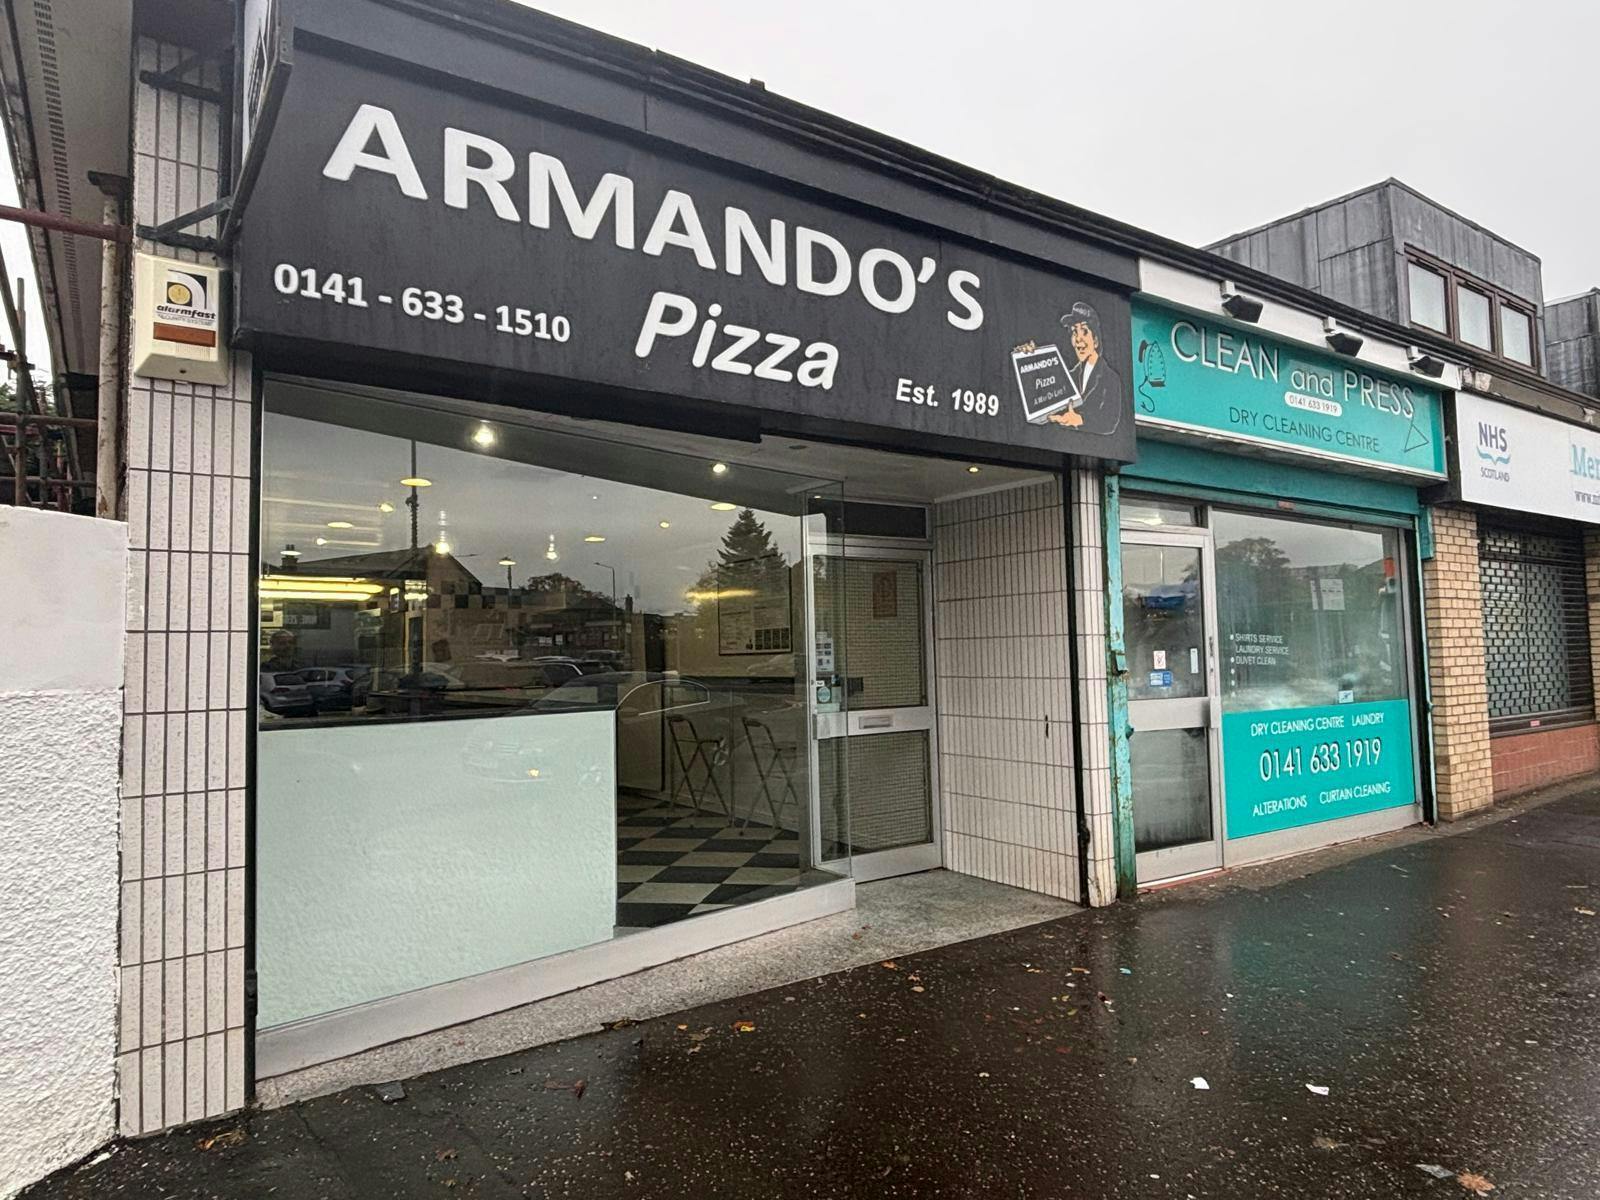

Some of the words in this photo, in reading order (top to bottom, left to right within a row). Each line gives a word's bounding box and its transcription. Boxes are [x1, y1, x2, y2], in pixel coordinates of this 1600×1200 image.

[322, 103, 984, 332] ARMANDO'S
[156, 305, 216, 319] alarmfast
[273, 263, 368, 308] 0141
[401, 287, 465, 325] 633
[495, 305, 571, 343] 1510
[634, 291, 839, 390] Pizza
[1020, 357, 1059, 374] ARMANDO'S
[1171, 321, 1279, 383] CLEAN
[1291, 370, 1334, 398] and
[1344, 369, 1414, 418] PRESS
[896, 377, 939, 408] Est.
[952, 388, 1000, 417] 1989
[1035, 376, 1056, 390] Pizza
[1289, 394, 1306, 406] 0141
[1308, 398, 1321, 409] 633
[1322, 401, 1338, 413] 1919
[1229, 406, 1258, 427] DRY
[1262, 413, 1332, 442] CLEANING
[1336, 430, 1380, 453] CENTRE
[1478, 421, 1508, 452] NHS
[1480, 467, 1510, 482] SCOTLAND
[1251, 723, 1268, 737] DRY
[1271, 718, 1314, 735] CLEANING
[1316, 716, 1345, 730] CENTRE
[1351, 712, 1384, 727] LAUNDRY
[1260, 746, 1302, 782] 0141
[1310, 742, 1341, 774] 633
[1346, 737, 1381, 768] 1919
[1253, 795, 1308, 817] ALTERATIONS
[1319, 787, 1352, 804] CURTAIN
[1353, 781, 1391, 798] CLEANING
